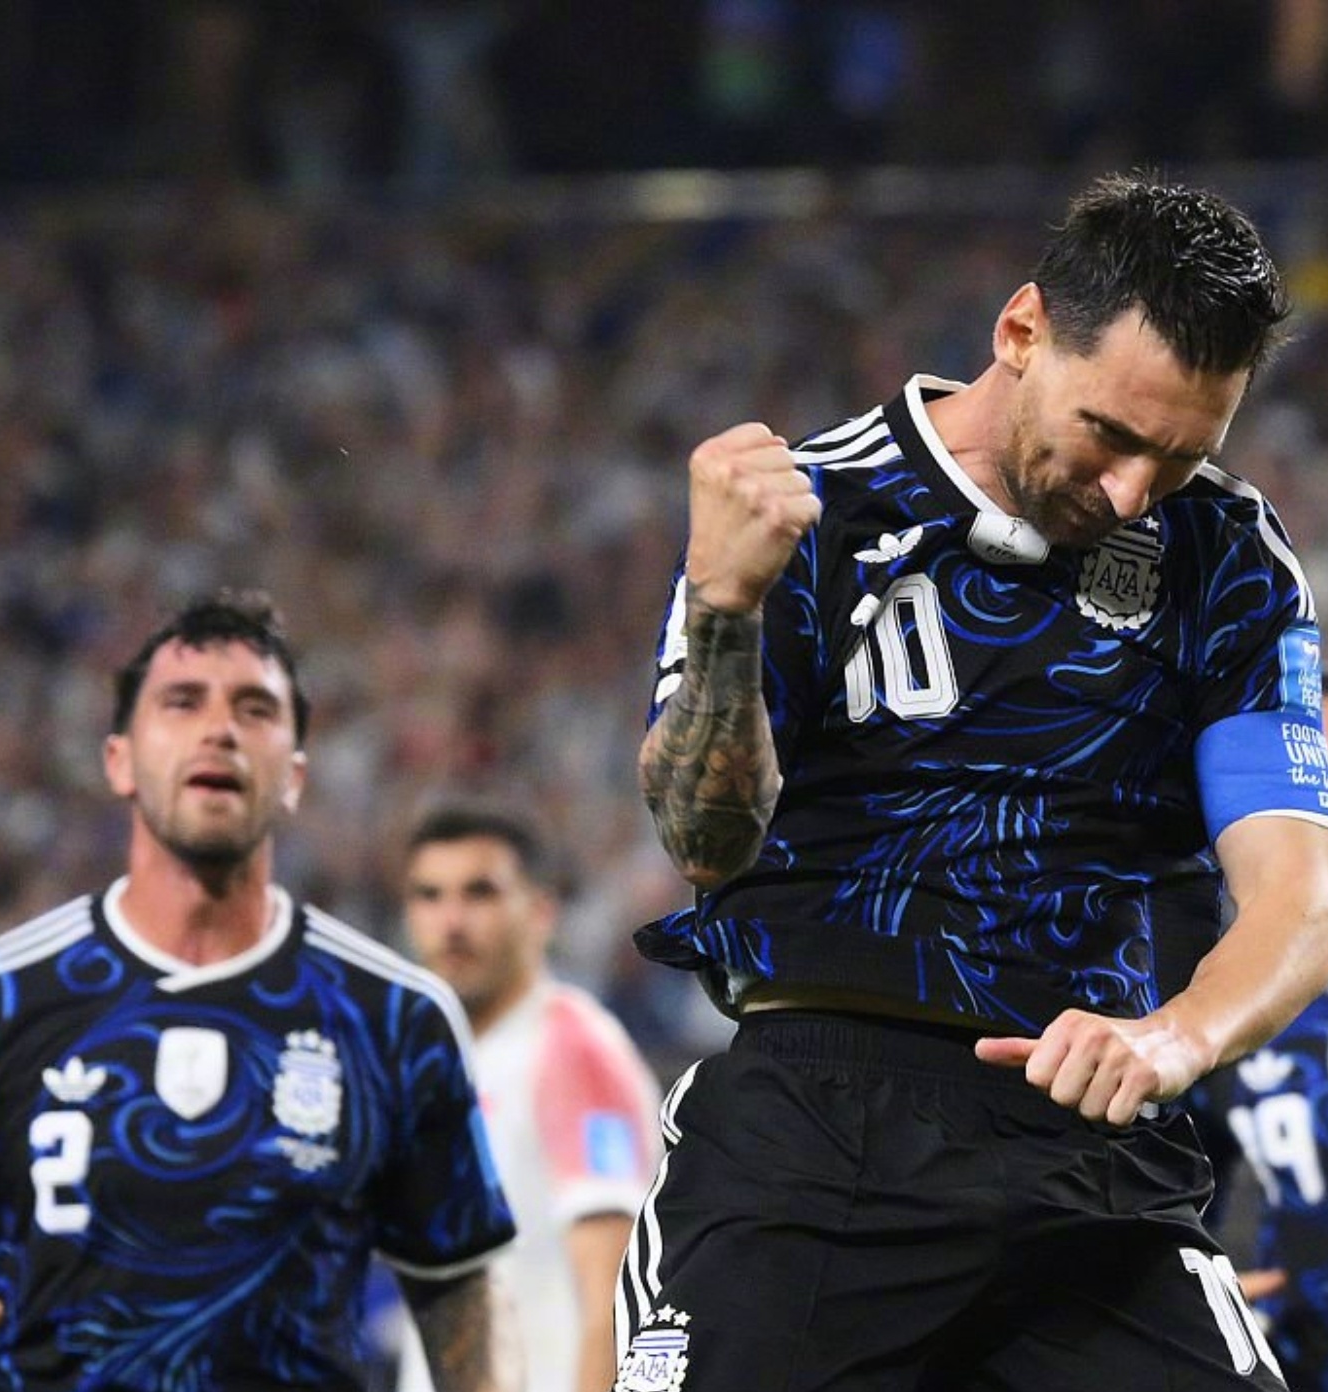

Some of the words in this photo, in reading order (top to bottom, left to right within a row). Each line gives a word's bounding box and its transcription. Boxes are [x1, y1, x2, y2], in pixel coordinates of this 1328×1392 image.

[1096, 553, 1140, 602] AFA
[844, 573, 961, 723] 10
[1286, 764, 1321, 786] the
[29, 1110, 93, 1234] 2
[1227, 1091, 1326, 1206] 19
[632, 1352, 670, 1384] AFA
